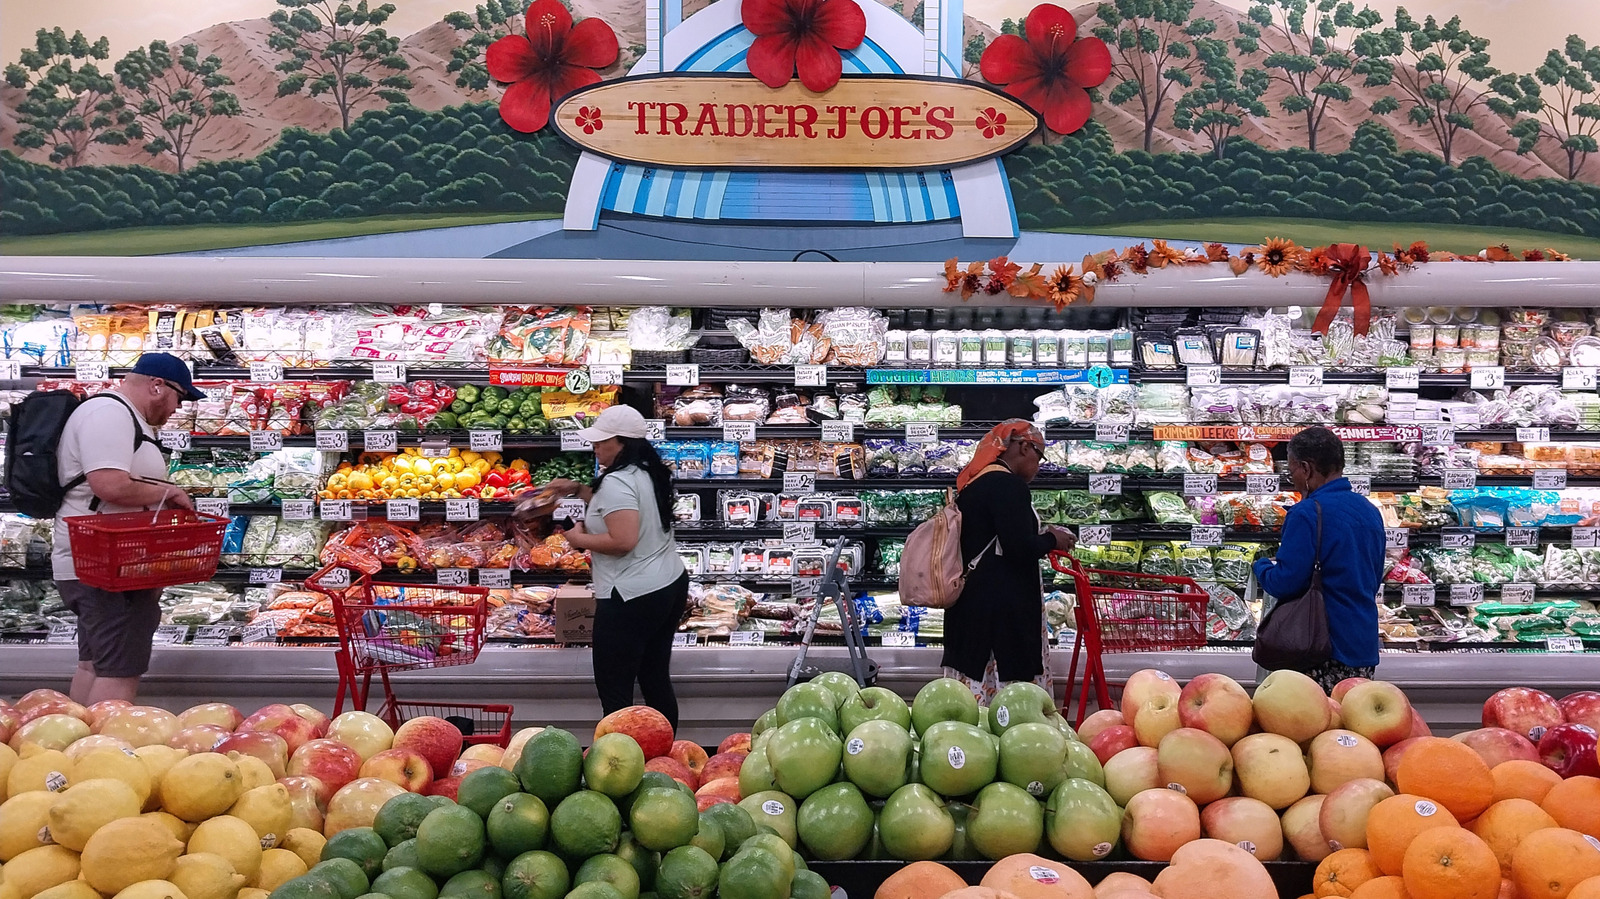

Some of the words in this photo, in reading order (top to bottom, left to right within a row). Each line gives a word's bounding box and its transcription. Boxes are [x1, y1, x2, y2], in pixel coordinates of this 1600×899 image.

[628, 101, 818, 139] TRADER
[826, 102, 956, 140] JOE'S
[522, 374, 535, 384] BABY
[535, 373, 546, 384] BOK
[930, 370, 976, 383] HERBS
[1154, 427, 1201, 439] TRIMMED
[1202, 428, 1235, 440] LEEKS
[1332, 428, 1379, 439] FENNEL
[1507, 529, 1529, 537] YELLOW
